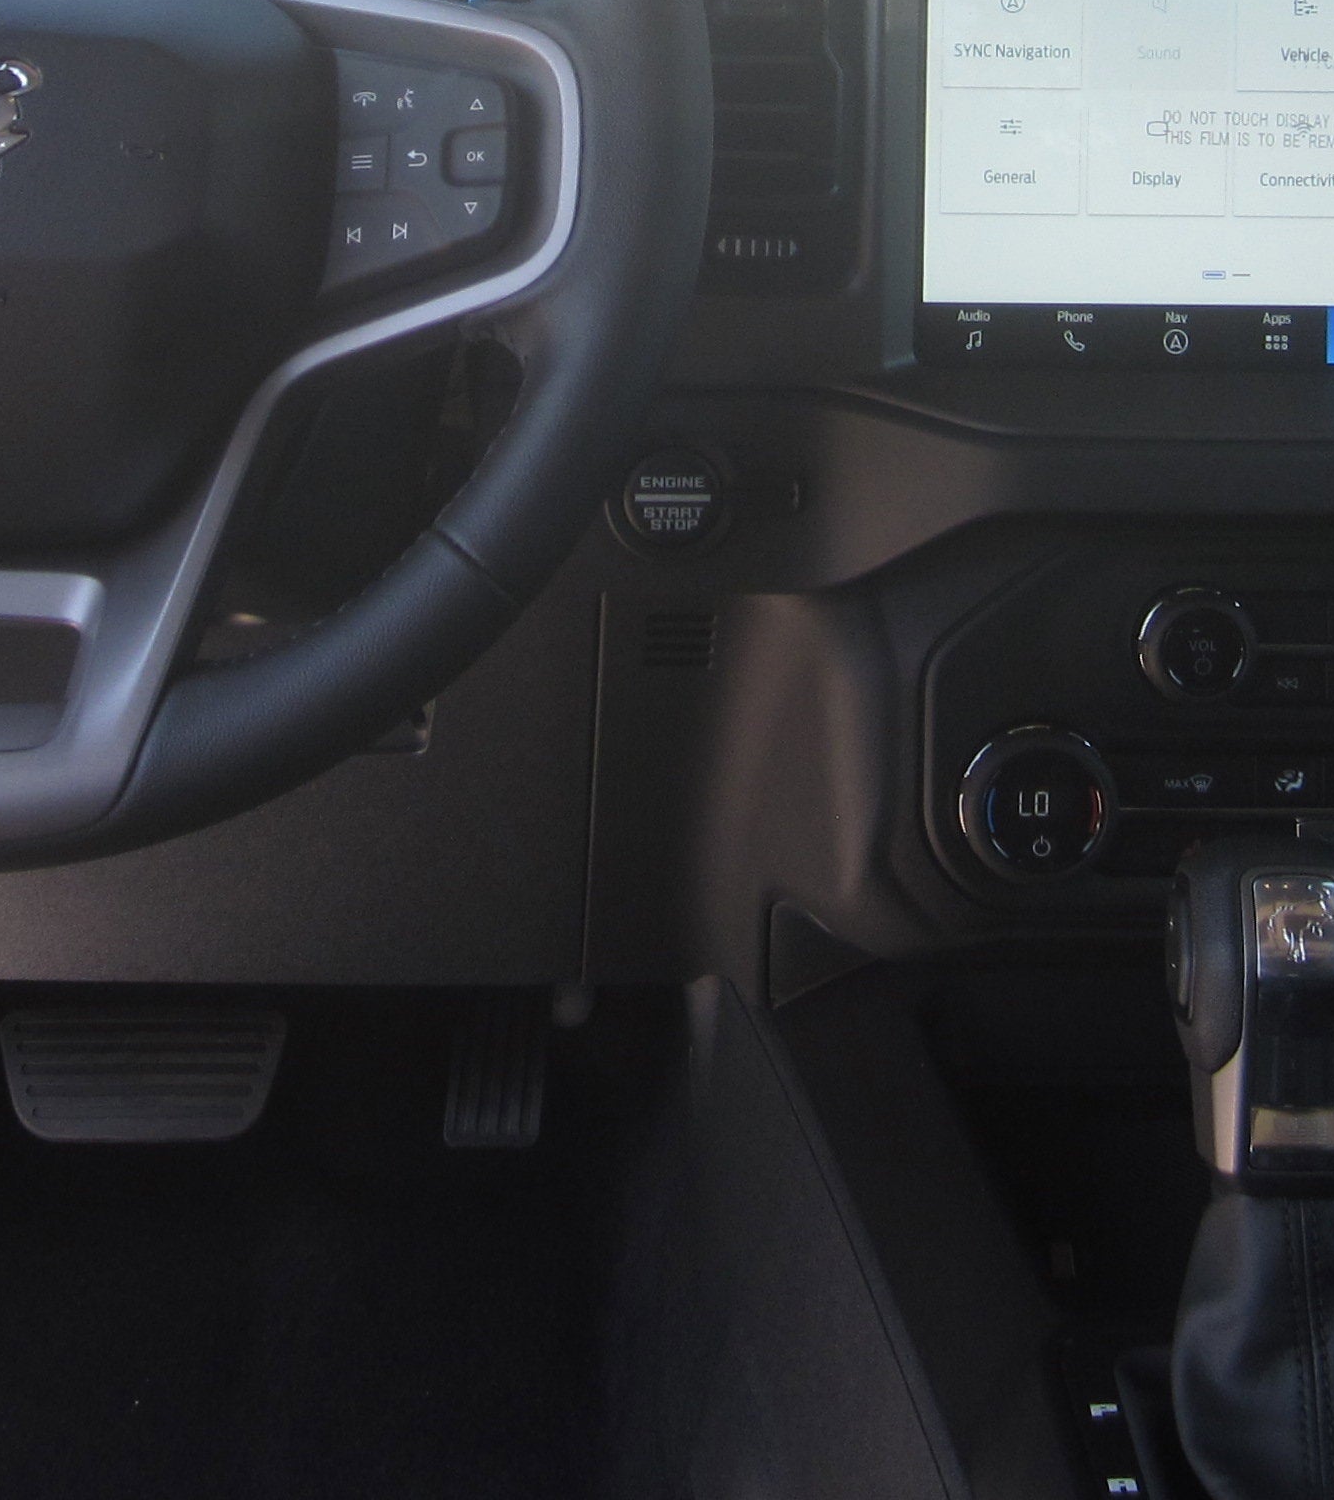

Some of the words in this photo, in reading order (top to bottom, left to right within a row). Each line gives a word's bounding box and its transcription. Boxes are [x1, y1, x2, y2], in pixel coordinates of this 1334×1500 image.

[954, 43, 992, 60] SYNC
[995, 43, 1071, 62] Navigation
[1137, 45, 1182, 61] Sound
[1280, 46, 1330, 63] Vehicle
[1162, 109, 1182, 125] DO
[1189, 110, 1217, 126] NOT
[1223, 111, 1269, 128] TOUCH
[1276, 113, 1331, 130] DISPLAY
[1162, 129, 1193, 146] THIS
[1200, 131, 1230, 147] FILM
[1237, 131, 1251, 148] IS
[1258, 132, 1276, 148] TO
[1282, 133, 1301, 149] BE
[466, 150, 485, 162] OK
[983, 169, 1037, 186] General
[1131, 170, 1182, 189] Display
[956, 308, 992, 324] Audio
[1056, 309, 1095, 325] Phone
[1164, 310, 1189, 325] Nav
[1262, 311, 1292, 327] Apps
[639, 475, 706, 490] ENGINE
[643, 506, 704, 519] START
[650, 519, 699, 531] STOP
[1187, 640, 1218, 652] VOL
